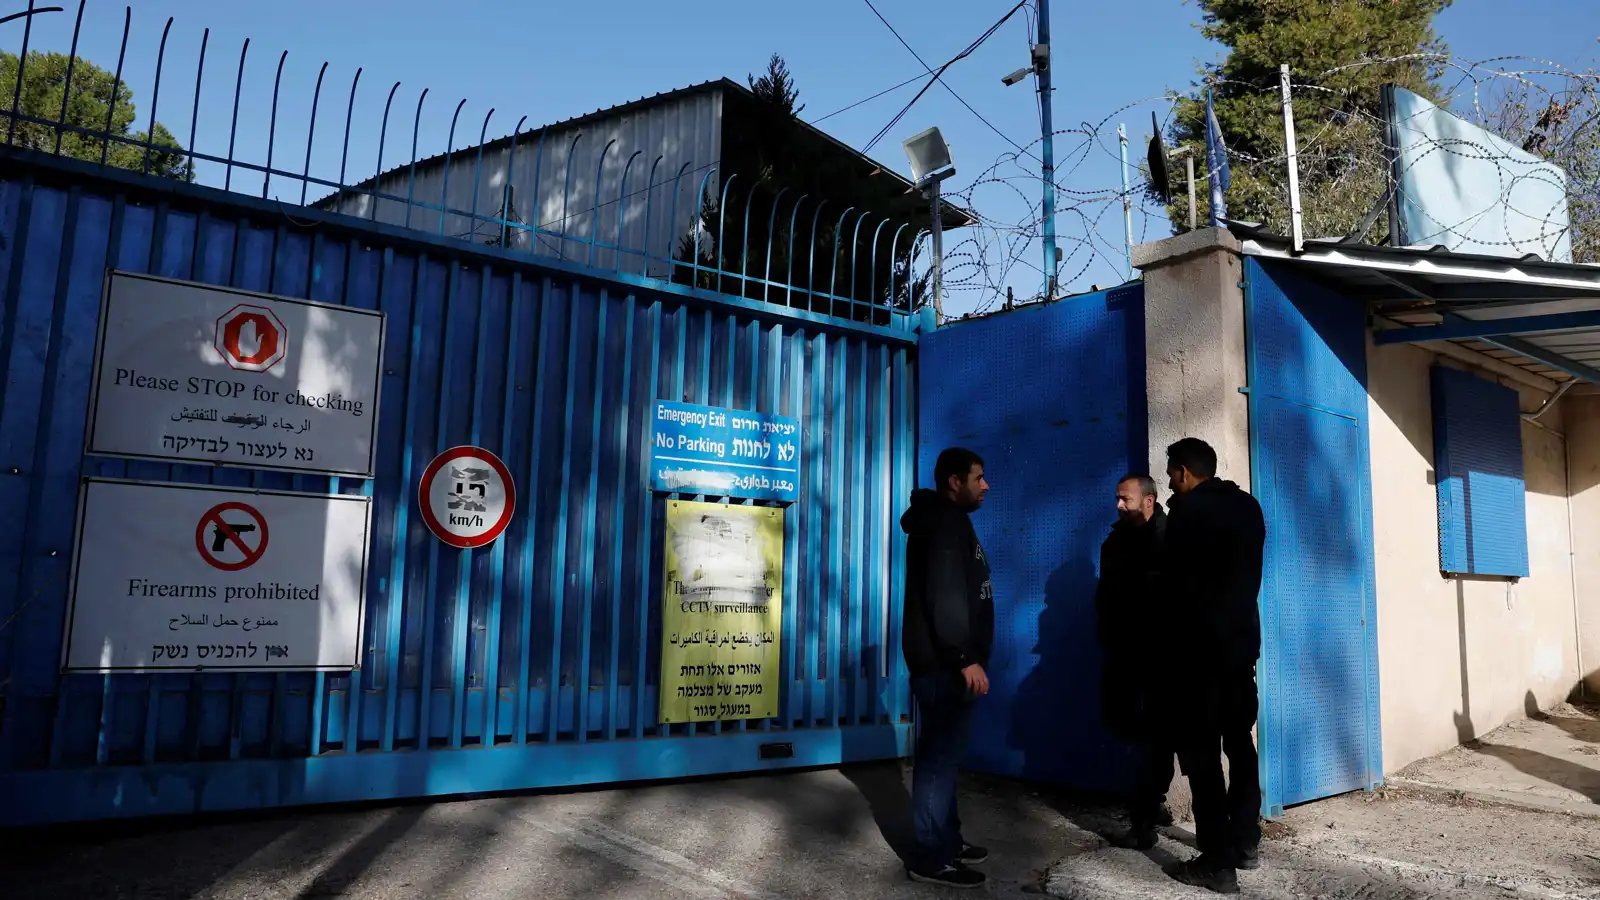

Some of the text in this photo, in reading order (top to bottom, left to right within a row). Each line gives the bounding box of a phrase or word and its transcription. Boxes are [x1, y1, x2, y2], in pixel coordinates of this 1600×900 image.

[114, 367, 363, 416] Please STOP for checking
[171, 406, 218, 421] للتفتيش
[658, 405, 726, 428] Emergency Exit
[272, 418, 311, 434] الرجاء
[732, 417, 795, 435] יציאת חרום
[163, 434, 314, 461] נא לעצור לבדיקה
[656, 432, 725, 457] No Parking
[732, 437, 795, 461] לא לחנות
[771, 478, 794, 492] معبر
[449, 513, 483, 527] km/h
[128, 579, 319, 603] Firearms prohibited
[681, 601, 768, 614] CCTV surveillance
[169, 614, 278, 631] ممنوع حمل السلاح
[670, 631, 703, 648] الكاميرات
[732, 632, 752, 650] يخضع
[755, 631, 774, 647] المكان
[152, 645, 188, 662] נשק
[197, 641, 257, 658] להכניס
[680, 663, 761, 677] אזורים אלו תחת
[677, 682, 763, 697] מעקב של מצלמה
[694, 703, 751, 718] במעגל סגור
